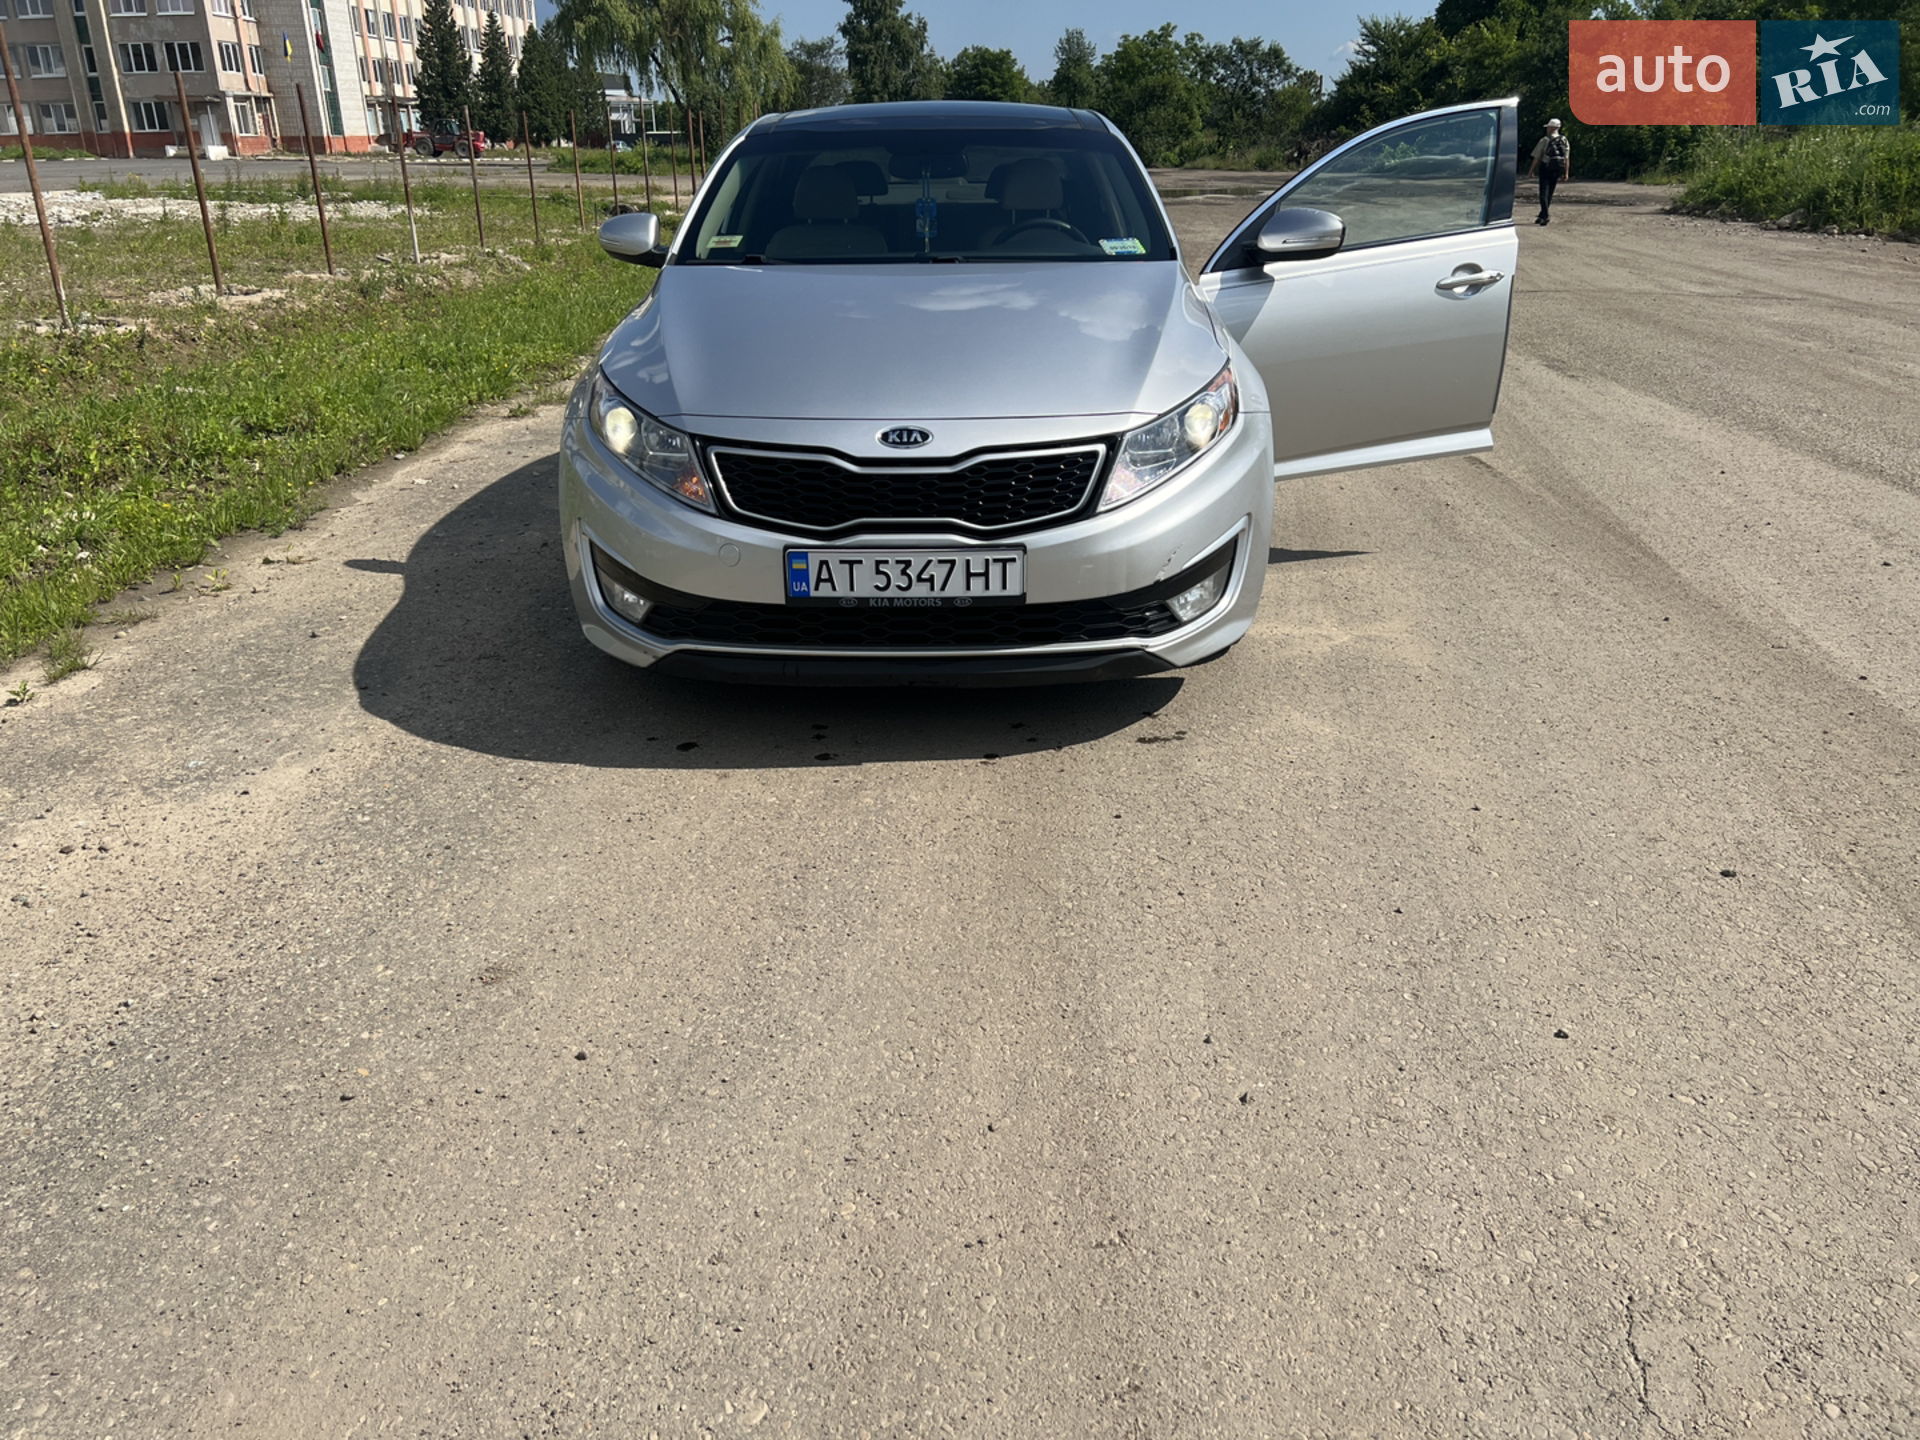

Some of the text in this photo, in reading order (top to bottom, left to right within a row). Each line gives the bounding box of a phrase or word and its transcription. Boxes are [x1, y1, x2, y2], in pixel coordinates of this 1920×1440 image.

[887, 430, 922, 443] KIA
[813, 557, 1017, 592] AT 5347 HT
[792, 581, 809, 592] UA
[869, 597, 942, 607] KIA MOTORS
